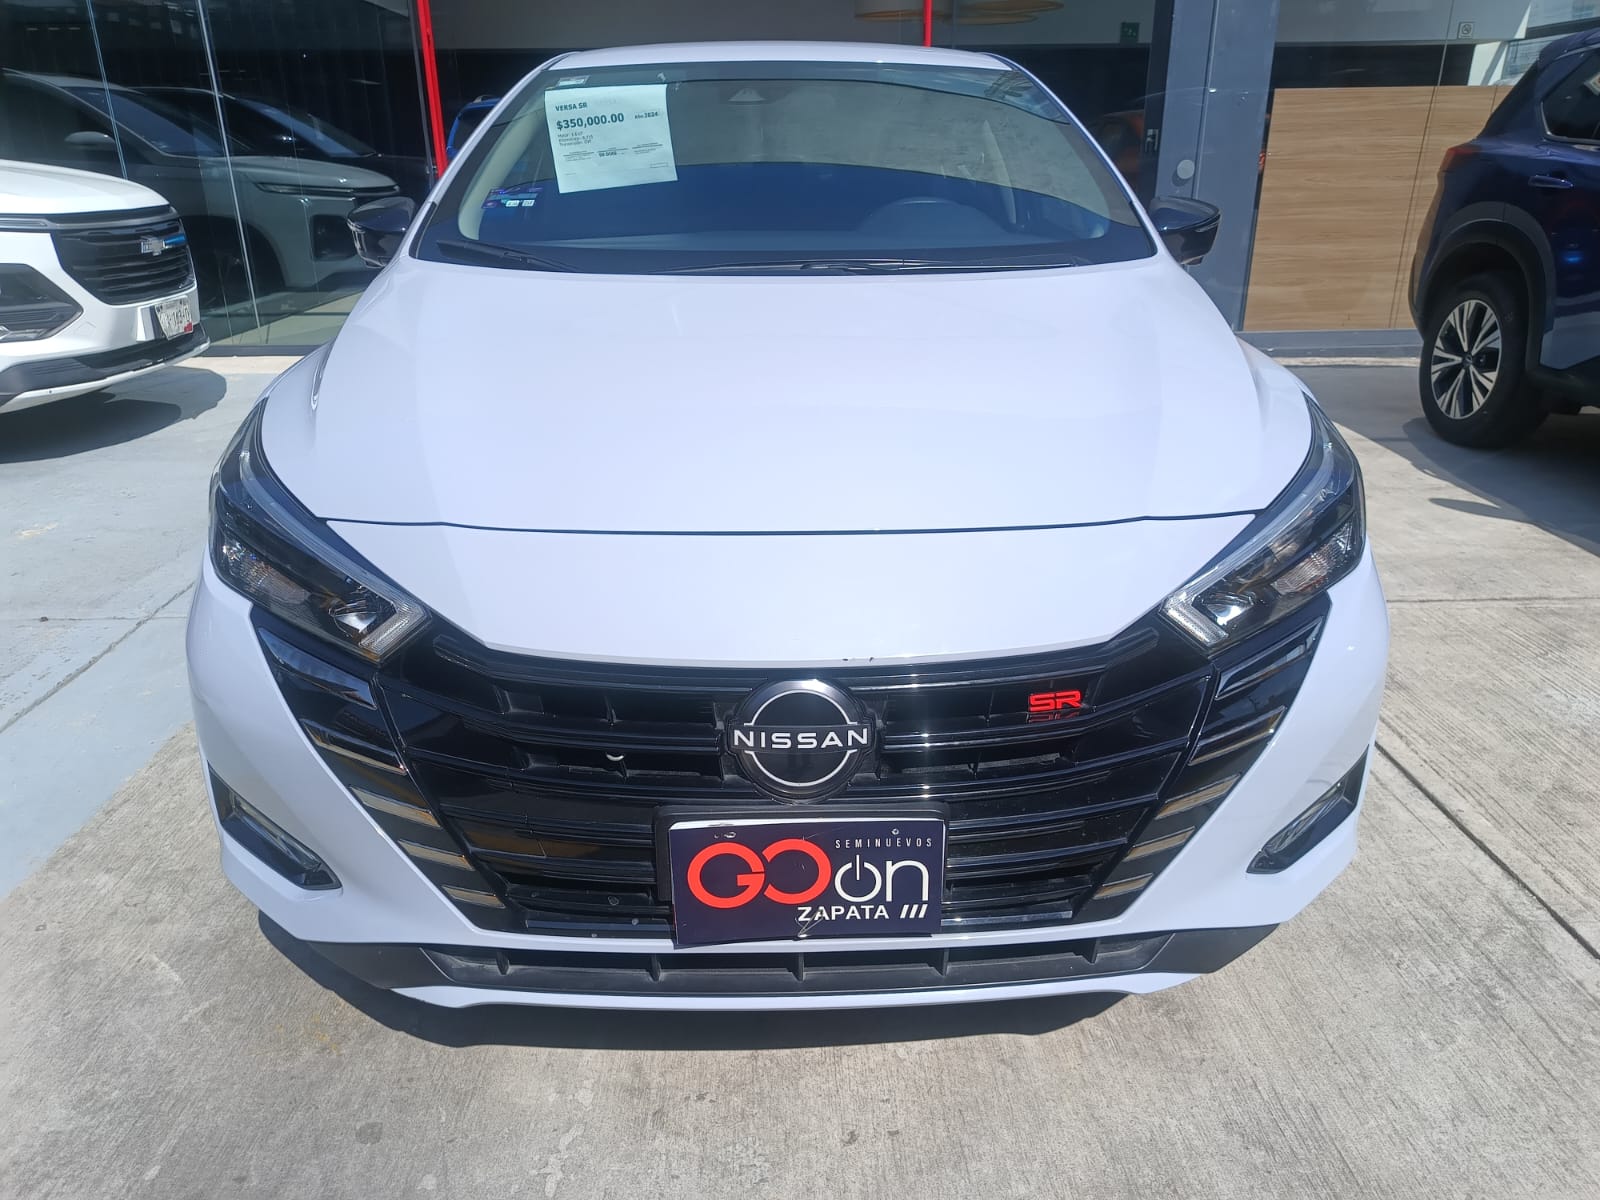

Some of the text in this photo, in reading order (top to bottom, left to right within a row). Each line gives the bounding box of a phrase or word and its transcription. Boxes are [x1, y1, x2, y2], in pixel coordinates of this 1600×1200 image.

[555, 103, 577, 111] VERSA
[556, 113, 625, 131] $350,000.00
[1028, 690, 1083, 712] SR
[733, 727, 869, 749] NISSAN
[835, 837, 933, 849] SEMINUEVOS
[797, 904, 890, 922] ZAPATA
